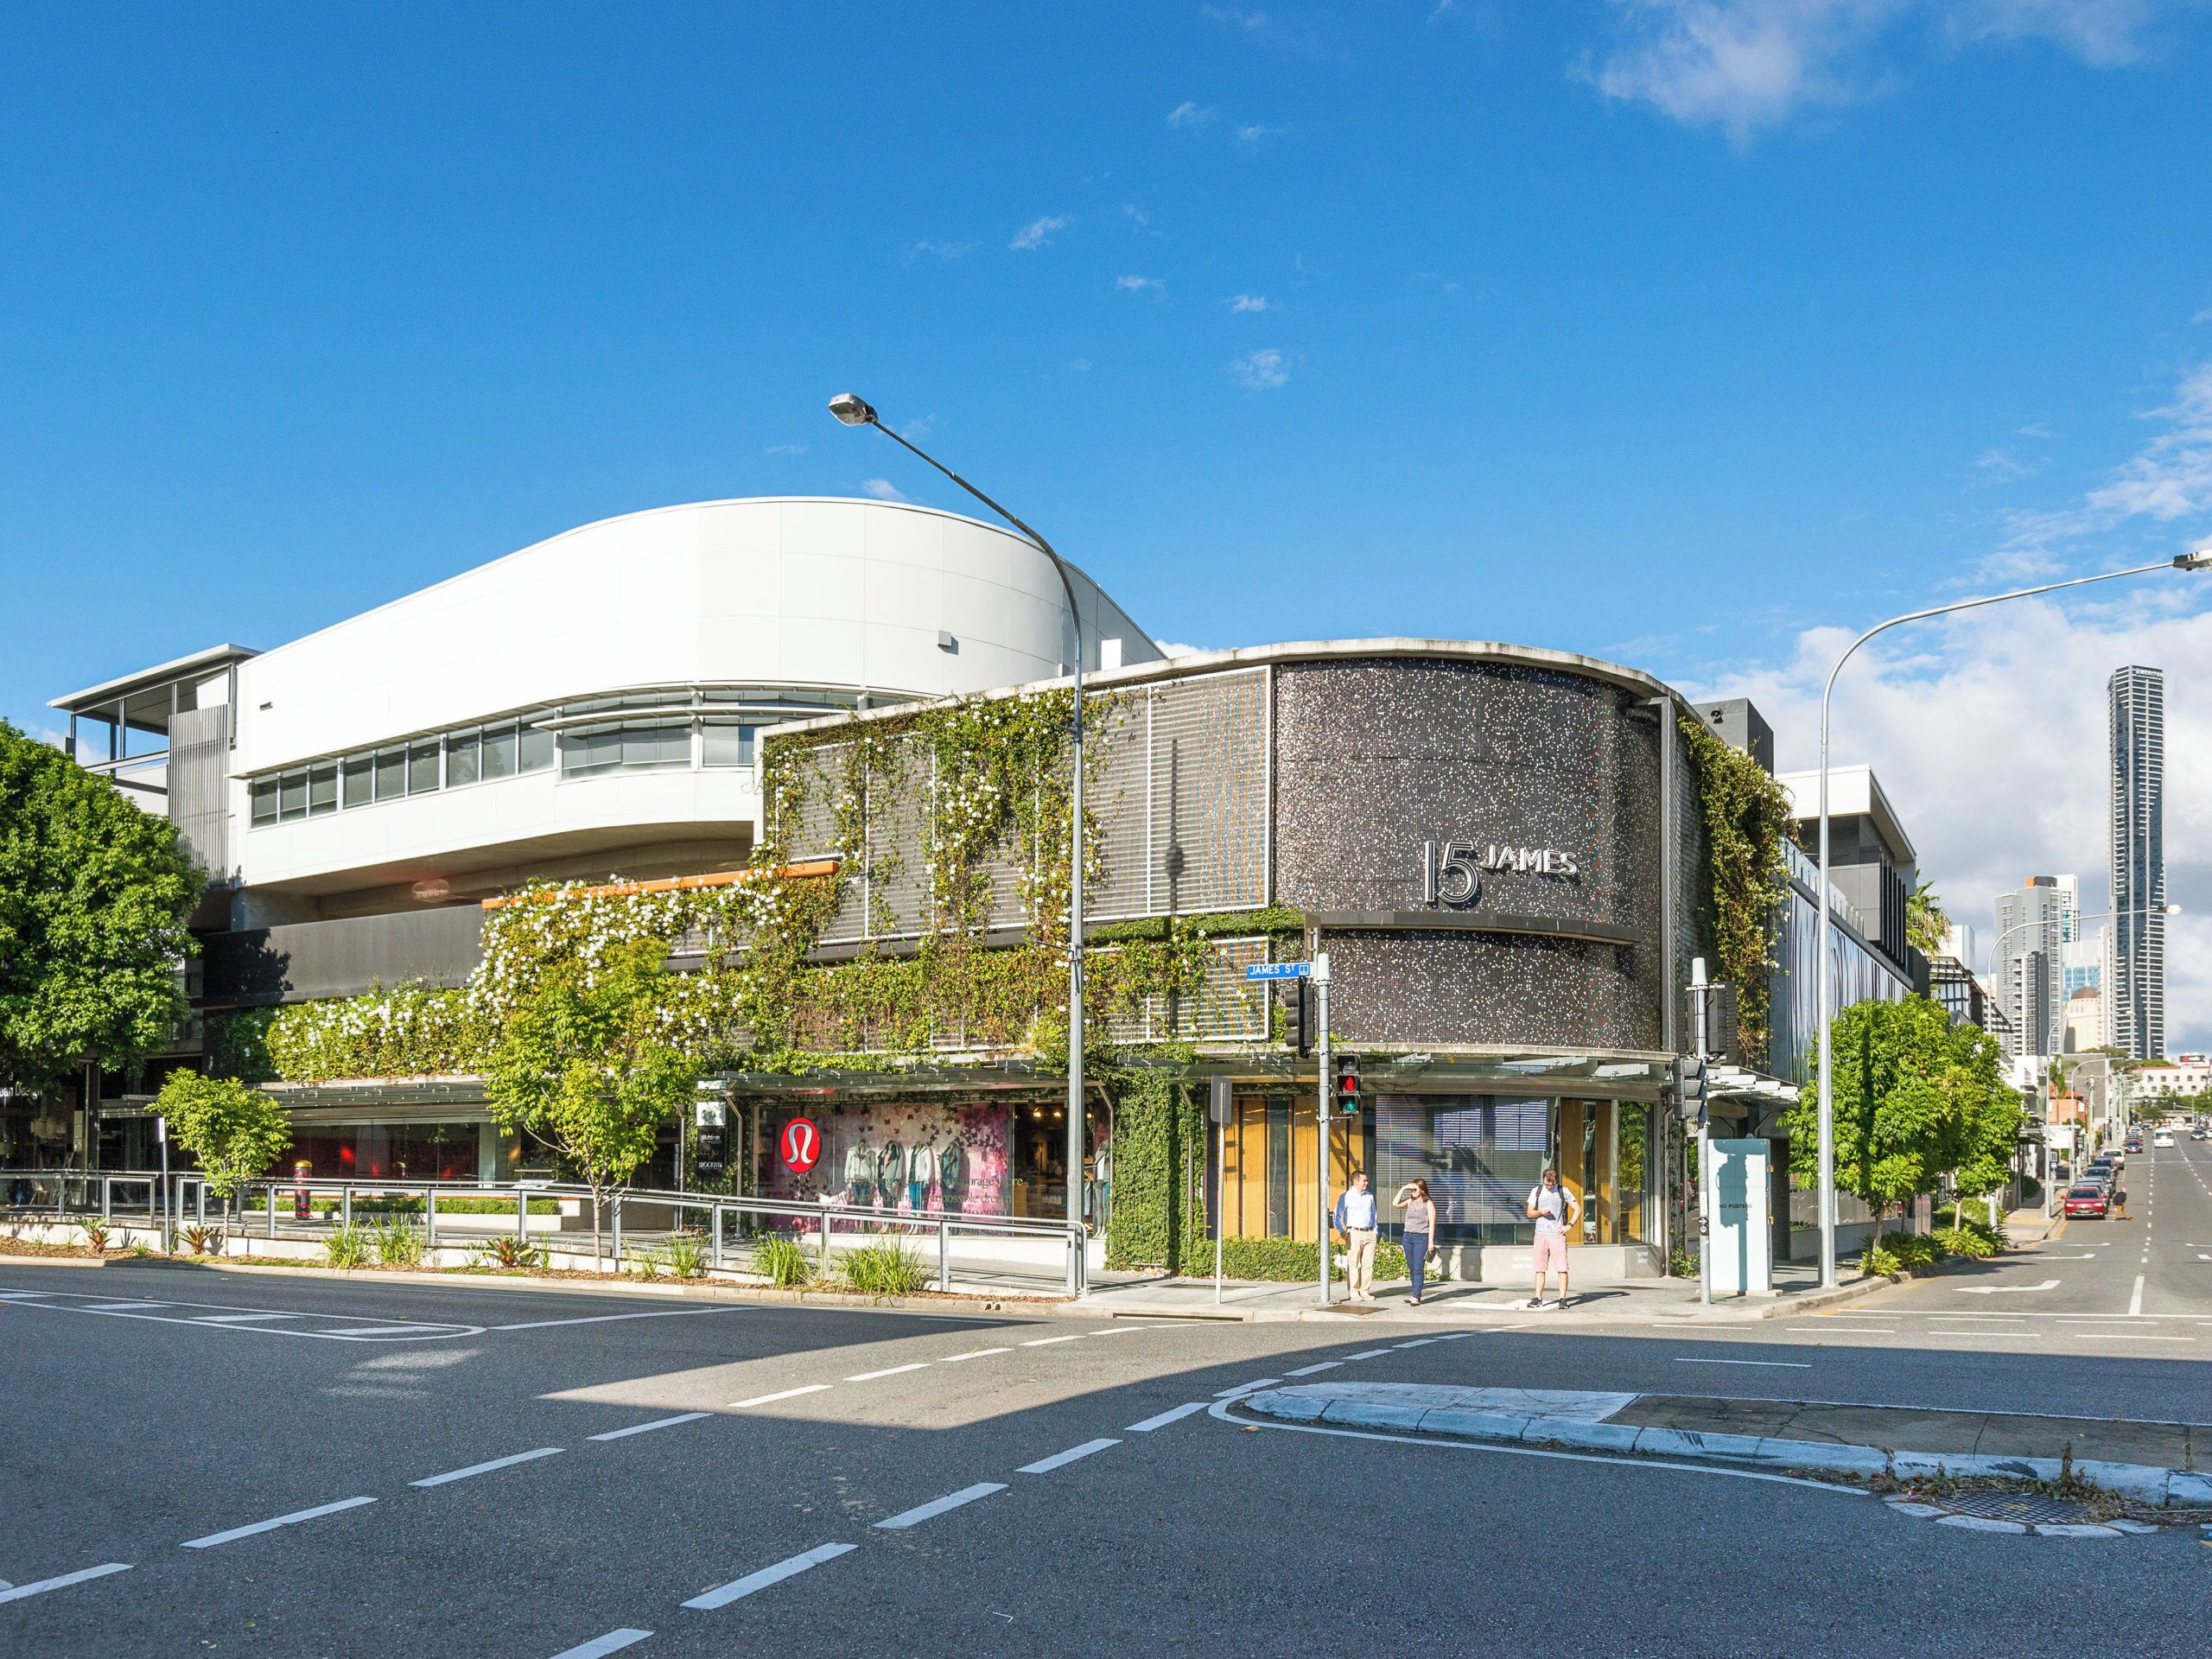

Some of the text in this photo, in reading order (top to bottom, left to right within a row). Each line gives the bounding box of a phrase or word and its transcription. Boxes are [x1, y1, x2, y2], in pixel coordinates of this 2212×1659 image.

[1425, 840, 1578, 904] 15 JAMES
[1250, 963, 1295, 976] JAMES ST
